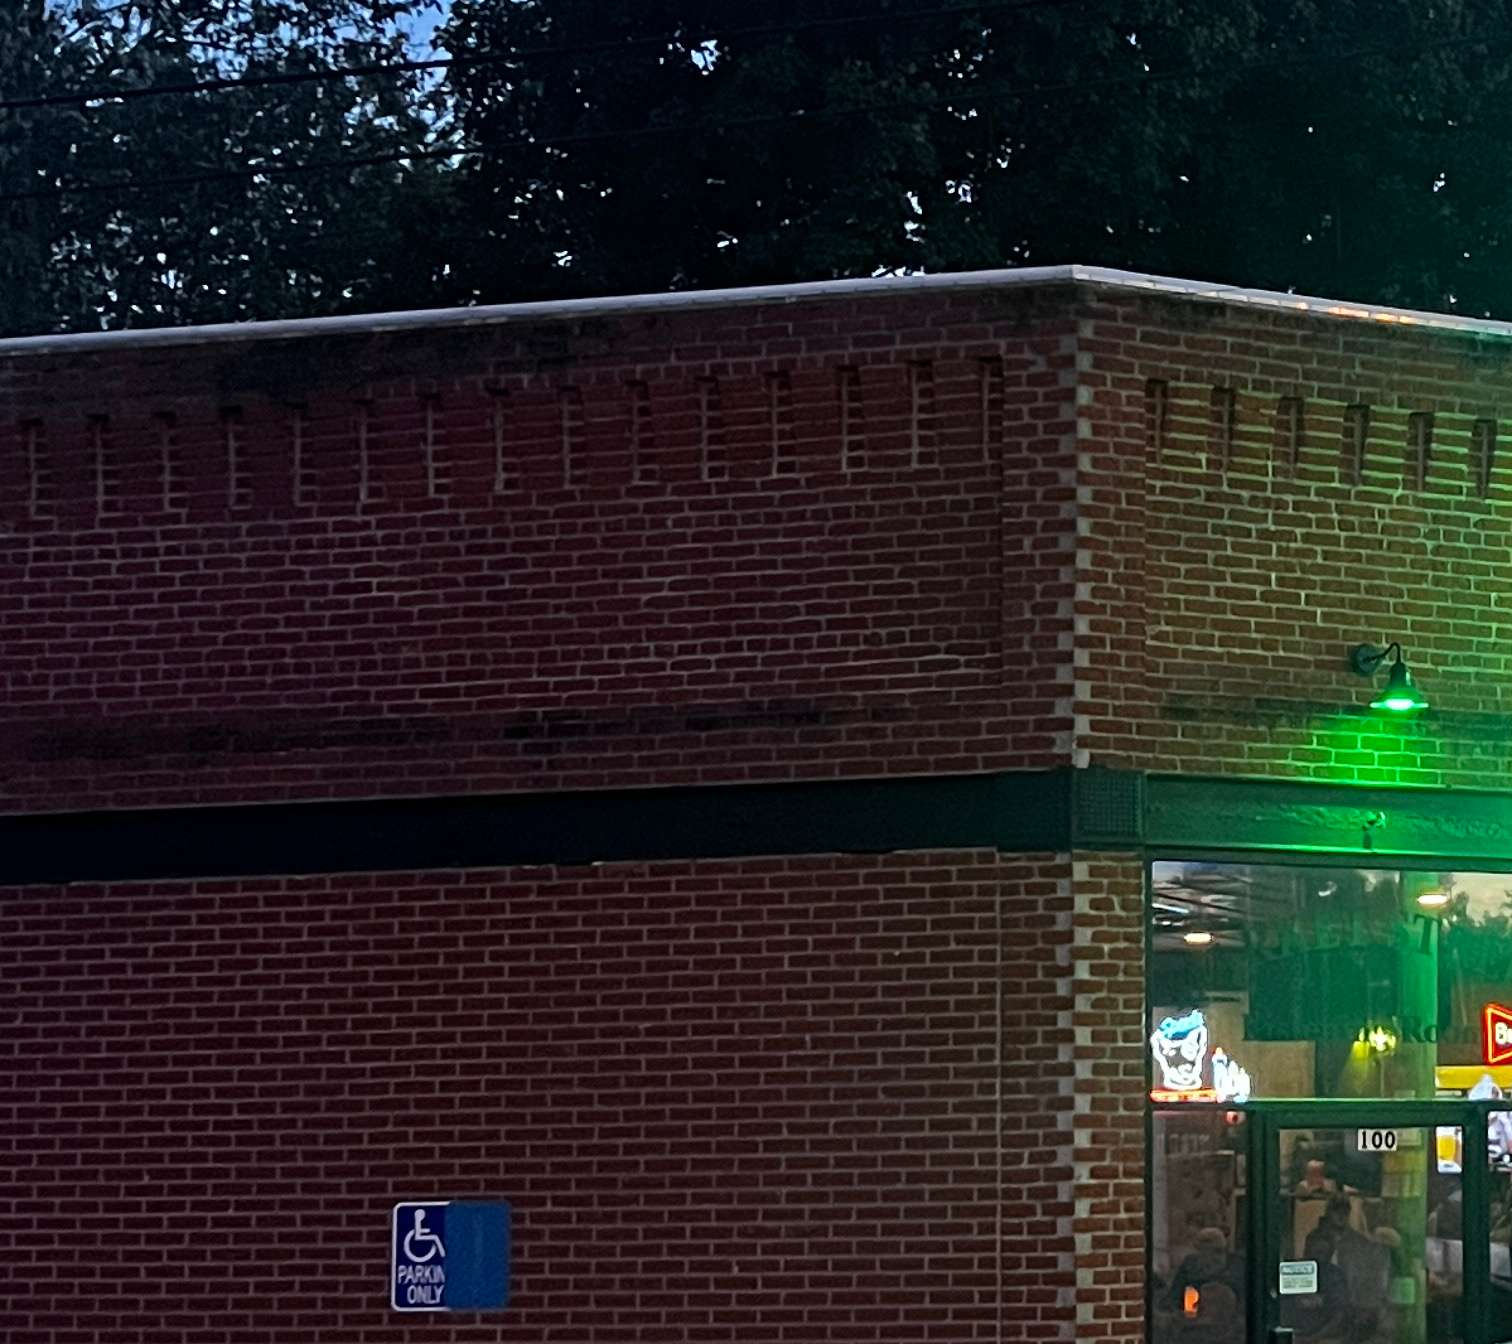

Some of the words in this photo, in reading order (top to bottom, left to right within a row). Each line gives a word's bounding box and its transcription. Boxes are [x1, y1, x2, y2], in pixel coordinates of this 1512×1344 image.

[1361, 1130, 1396, 1149] 100
[397, 1264, 446, 1284] PARKIN
[406, 1285, 445, 1304] ONLY
